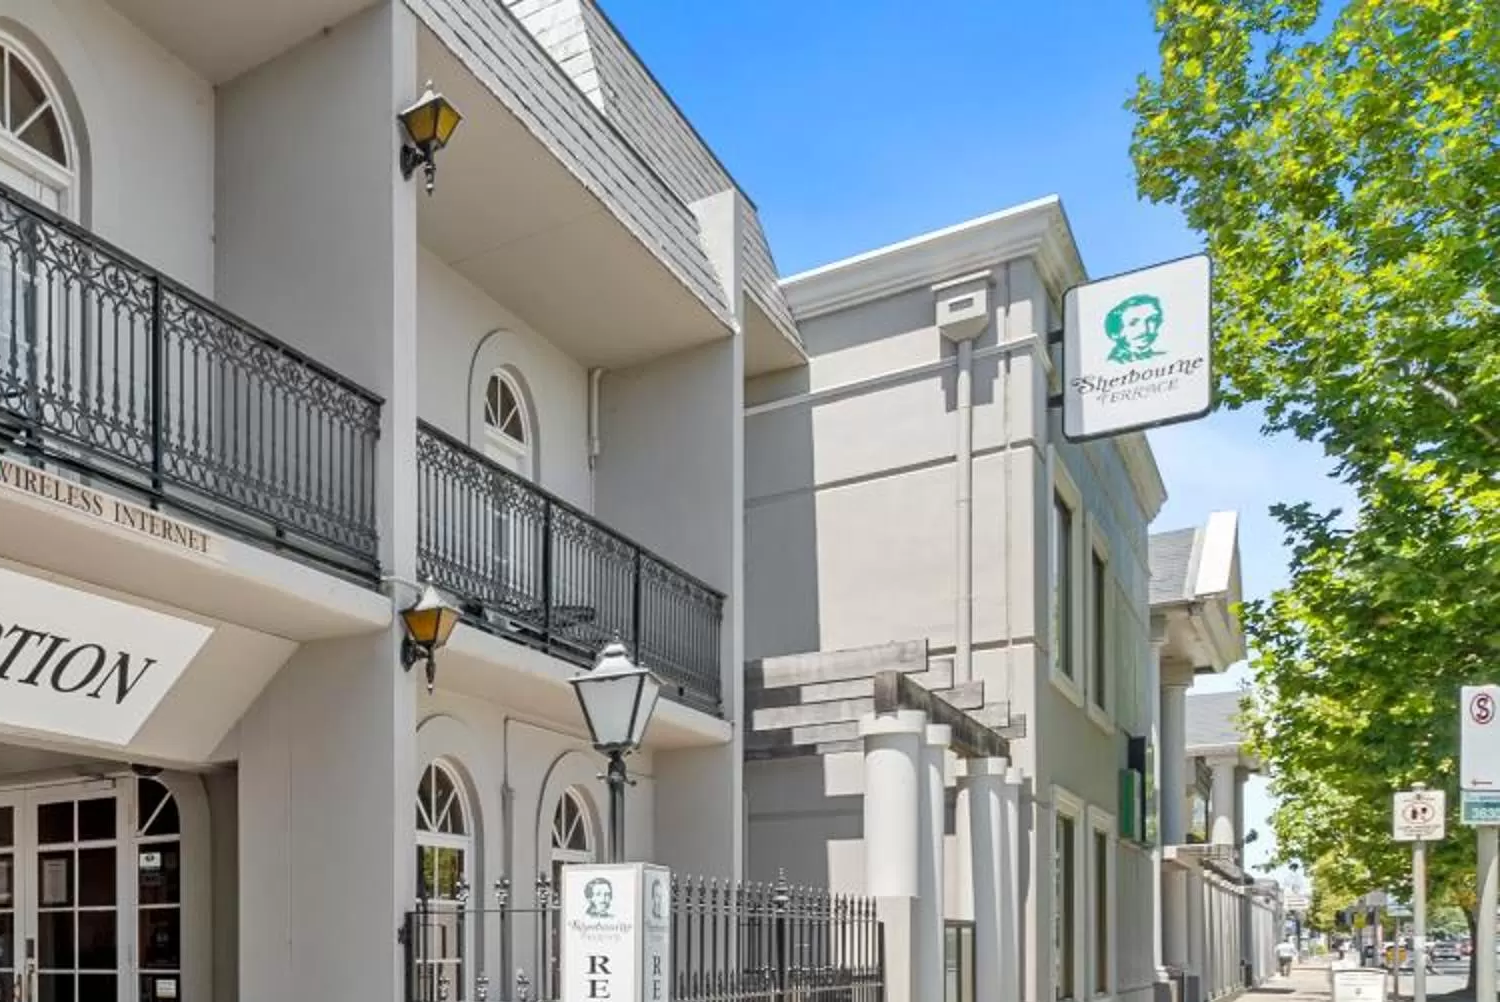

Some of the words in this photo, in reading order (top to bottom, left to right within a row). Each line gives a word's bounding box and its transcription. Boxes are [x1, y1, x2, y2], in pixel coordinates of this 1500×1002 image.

[1071, 355, 1204, 395] Sherbourne
[1096, 378, 1180, 405] TERRACE
[113, 502, 212, 553] INTERNET
